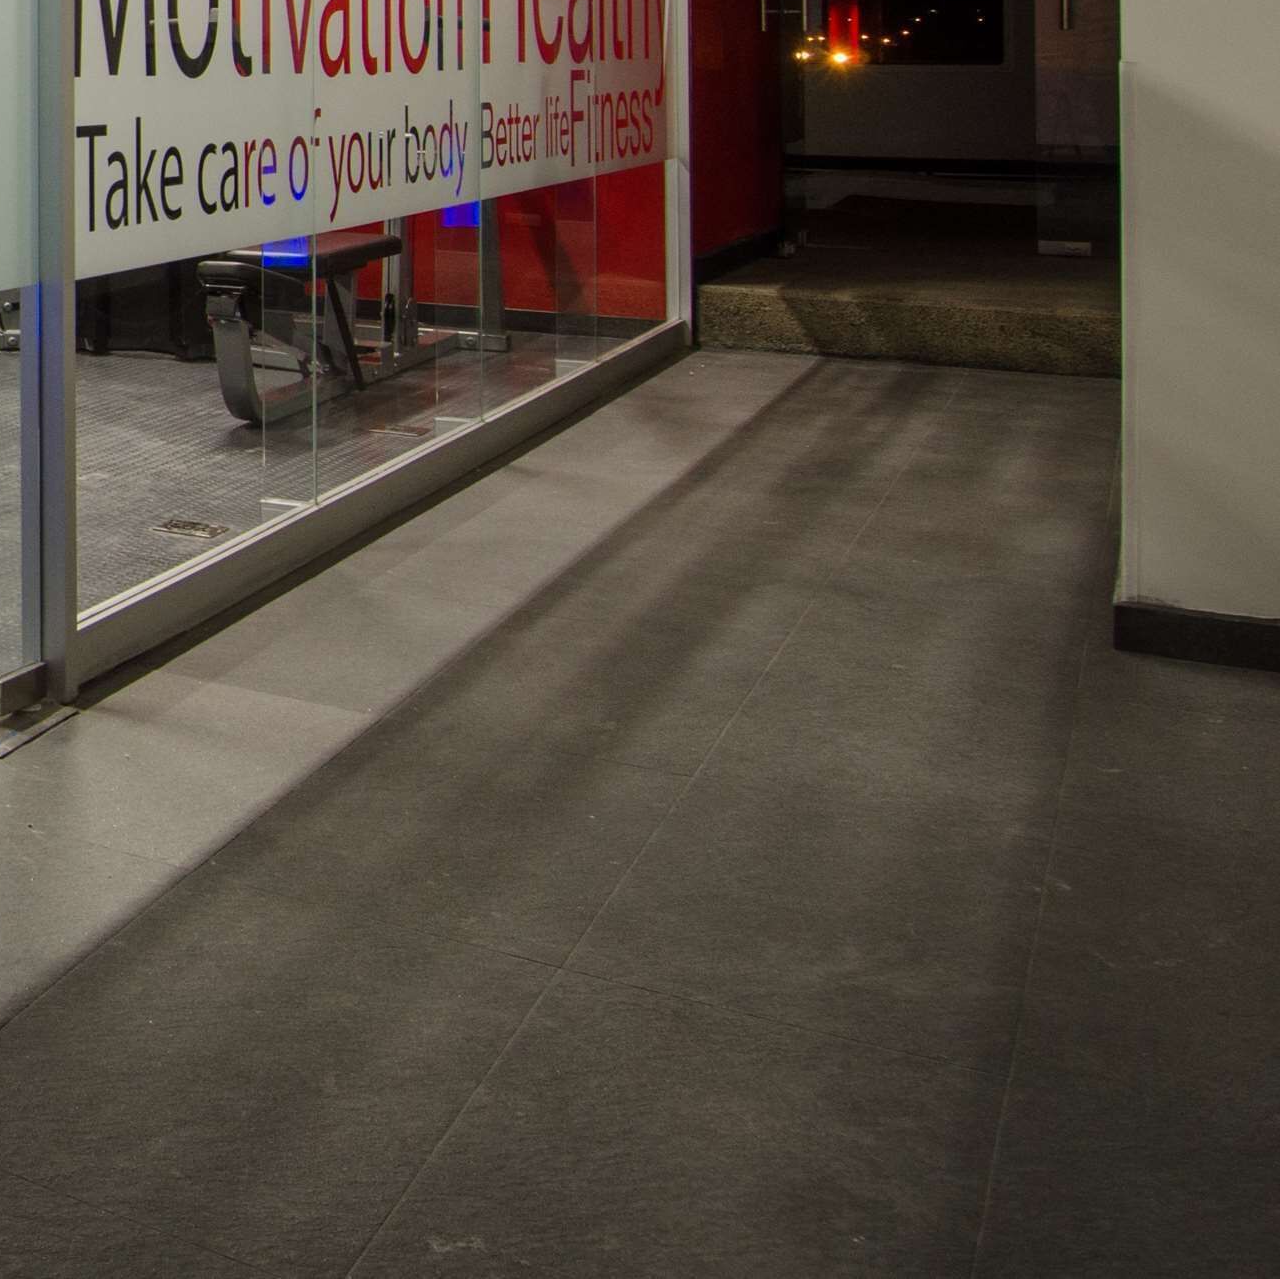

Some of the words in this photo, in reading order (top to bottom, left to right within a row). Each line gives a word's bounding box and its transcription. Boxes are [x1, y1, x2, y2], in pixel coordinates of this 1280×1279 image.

[75, 116, 184, 233] Take
[197, 136, 278, 216] care
[327, 126, 397, 223] your
[404, 99, 469, 199] body
[480, 101, 540, 170] Better
[545, 95, 570, 159] life
